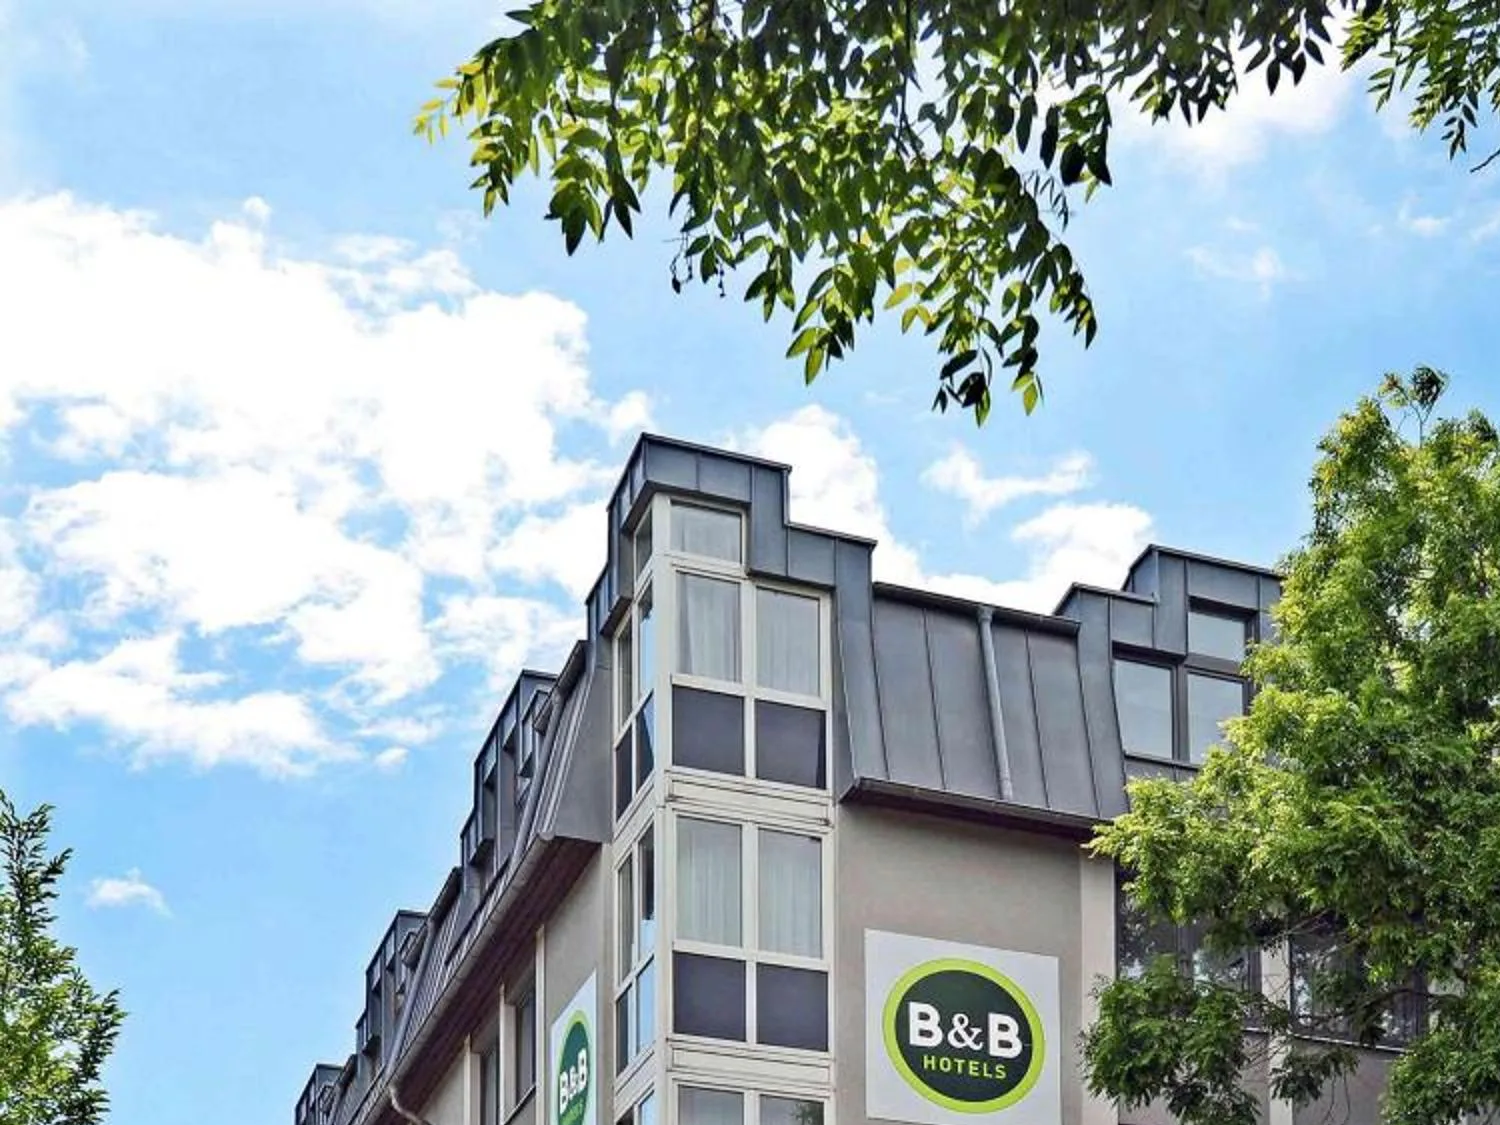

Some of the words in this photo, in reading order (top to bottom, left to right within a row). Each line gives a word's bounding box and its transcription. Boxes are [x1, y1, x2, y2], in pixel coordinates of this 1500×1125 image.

[907, 1001, 1023, 1059] B&B
[560, 1047, 587, 1114] B&B
[923, 1054, 1007, 1079] HOTELS
